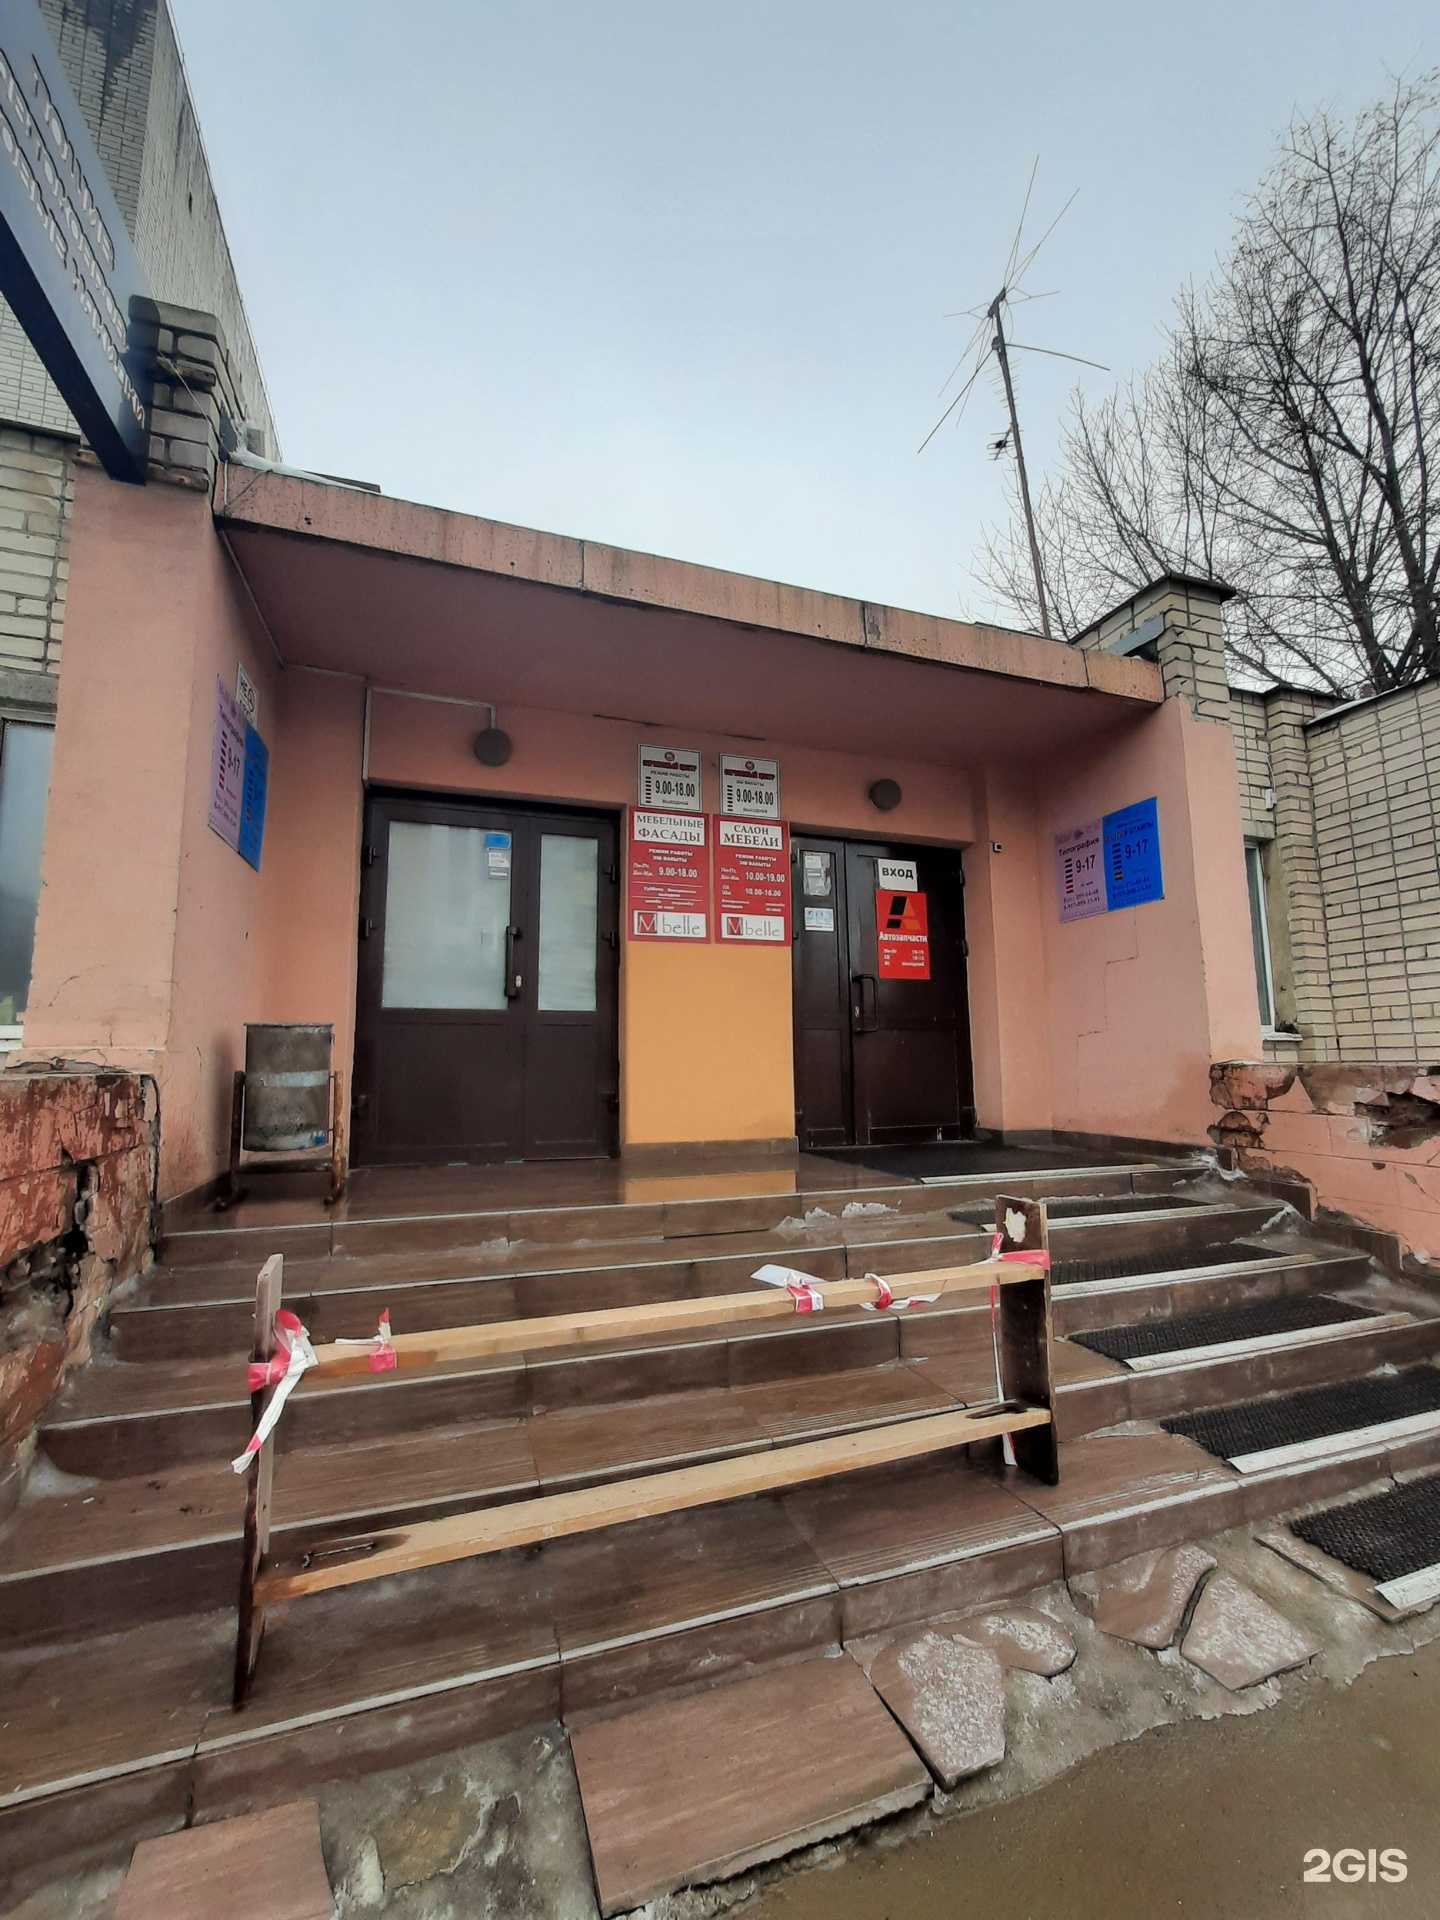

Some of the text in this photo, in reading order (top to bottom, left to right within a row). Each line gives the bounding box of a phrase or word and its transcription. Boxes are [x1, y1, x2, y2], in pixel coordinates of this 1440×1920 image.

[655, 780, 695, 797] 9.00-18.00
[736, 788, 774, 806] 9.00-18.00
[637, 815, 703, 828] МЕБЕЛЬНЫЕ
[638, 828, 700, 842] ФАСАДЫ
[734, 824, 769, 835] САЛОН
[724, 833, 779, 848] МЕБЕЛИ
[1075, 854, 1096, 874] 9-17
[658, 866, 698, 878] 9.00-18.00
[746, 872, 785, 883] 10.00-19.00
[882, 867, 914, 880] ВХОД
[880, 932, 928, 943] Автозапчасти
